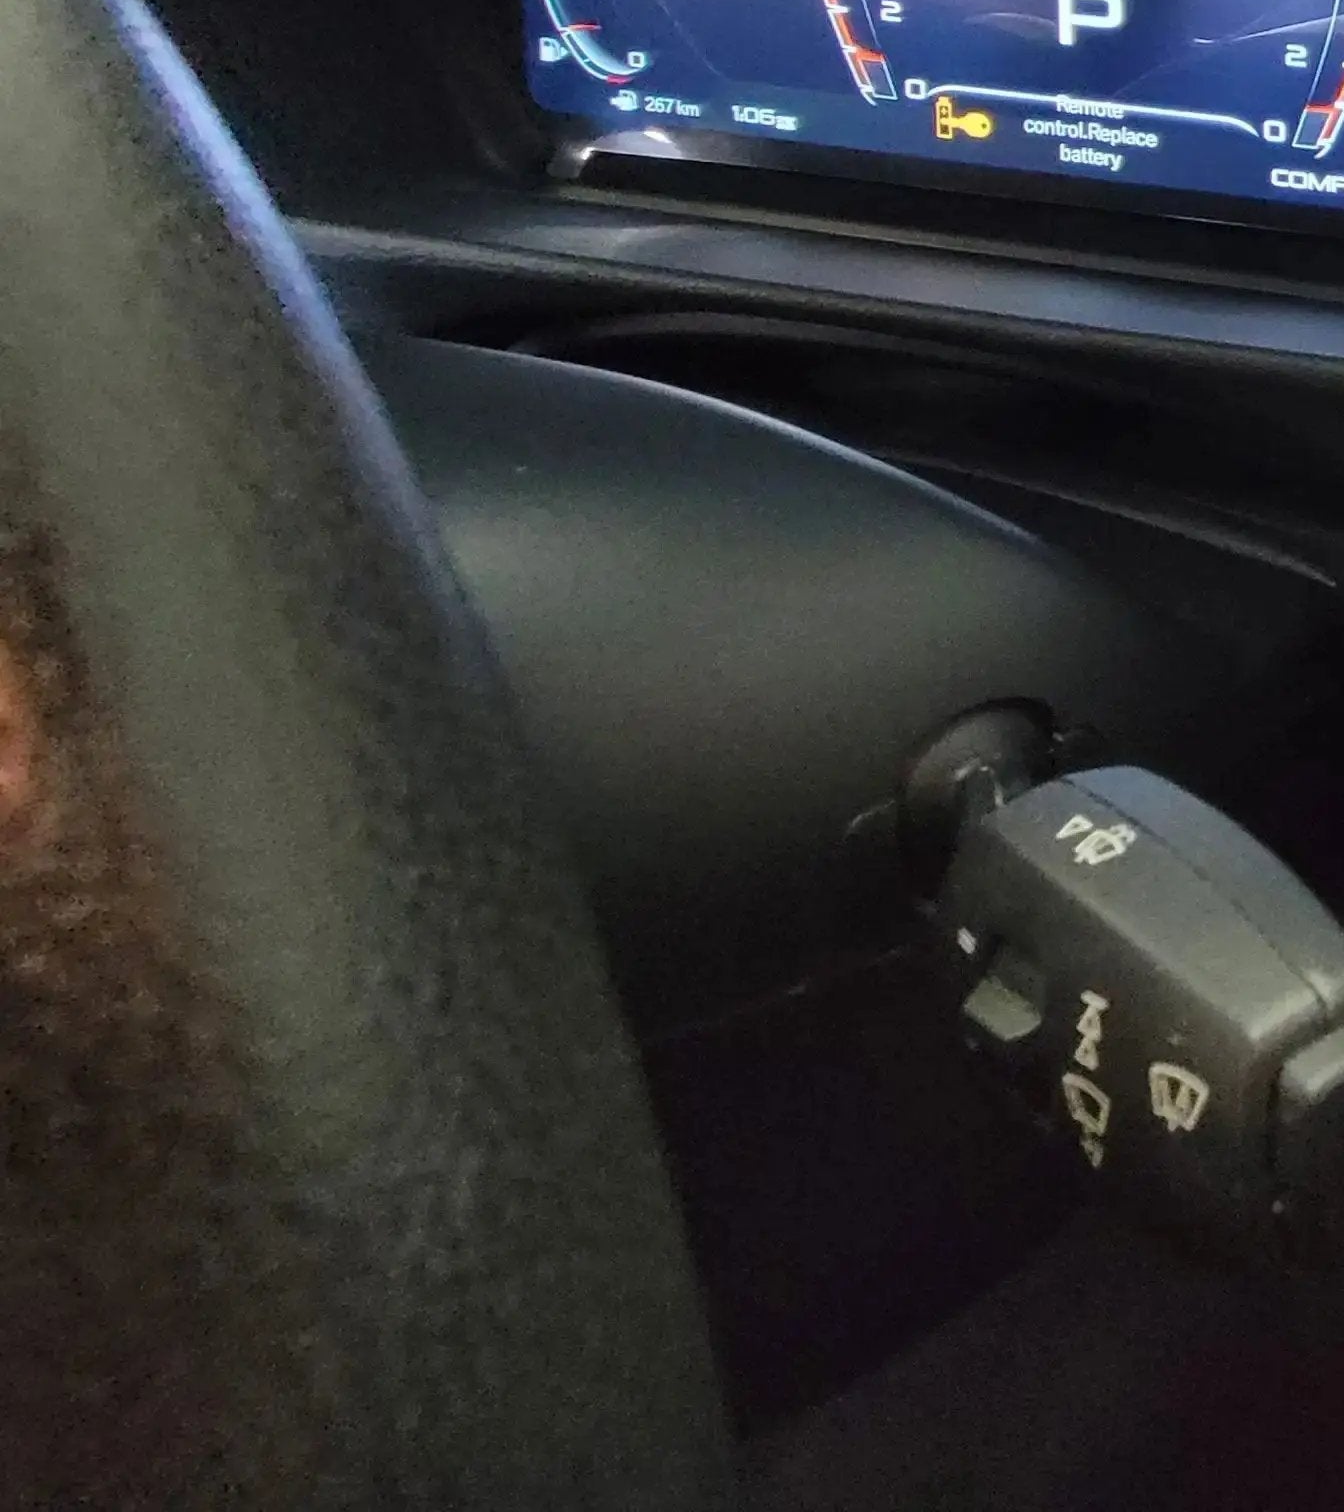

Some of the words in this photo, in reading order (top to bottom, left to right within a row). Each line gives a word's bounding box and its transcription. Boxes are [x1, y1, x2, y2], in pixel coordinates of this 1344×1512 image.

[879, 0, 903, 23] 2
[1285, 45, 1308, 69] 2
[644, 96, 674, 114] 267
[676, 99, 700, 118] km
[1055, 93, 1126, 120] Remote
[1058, 143, 1124, 172] battery
